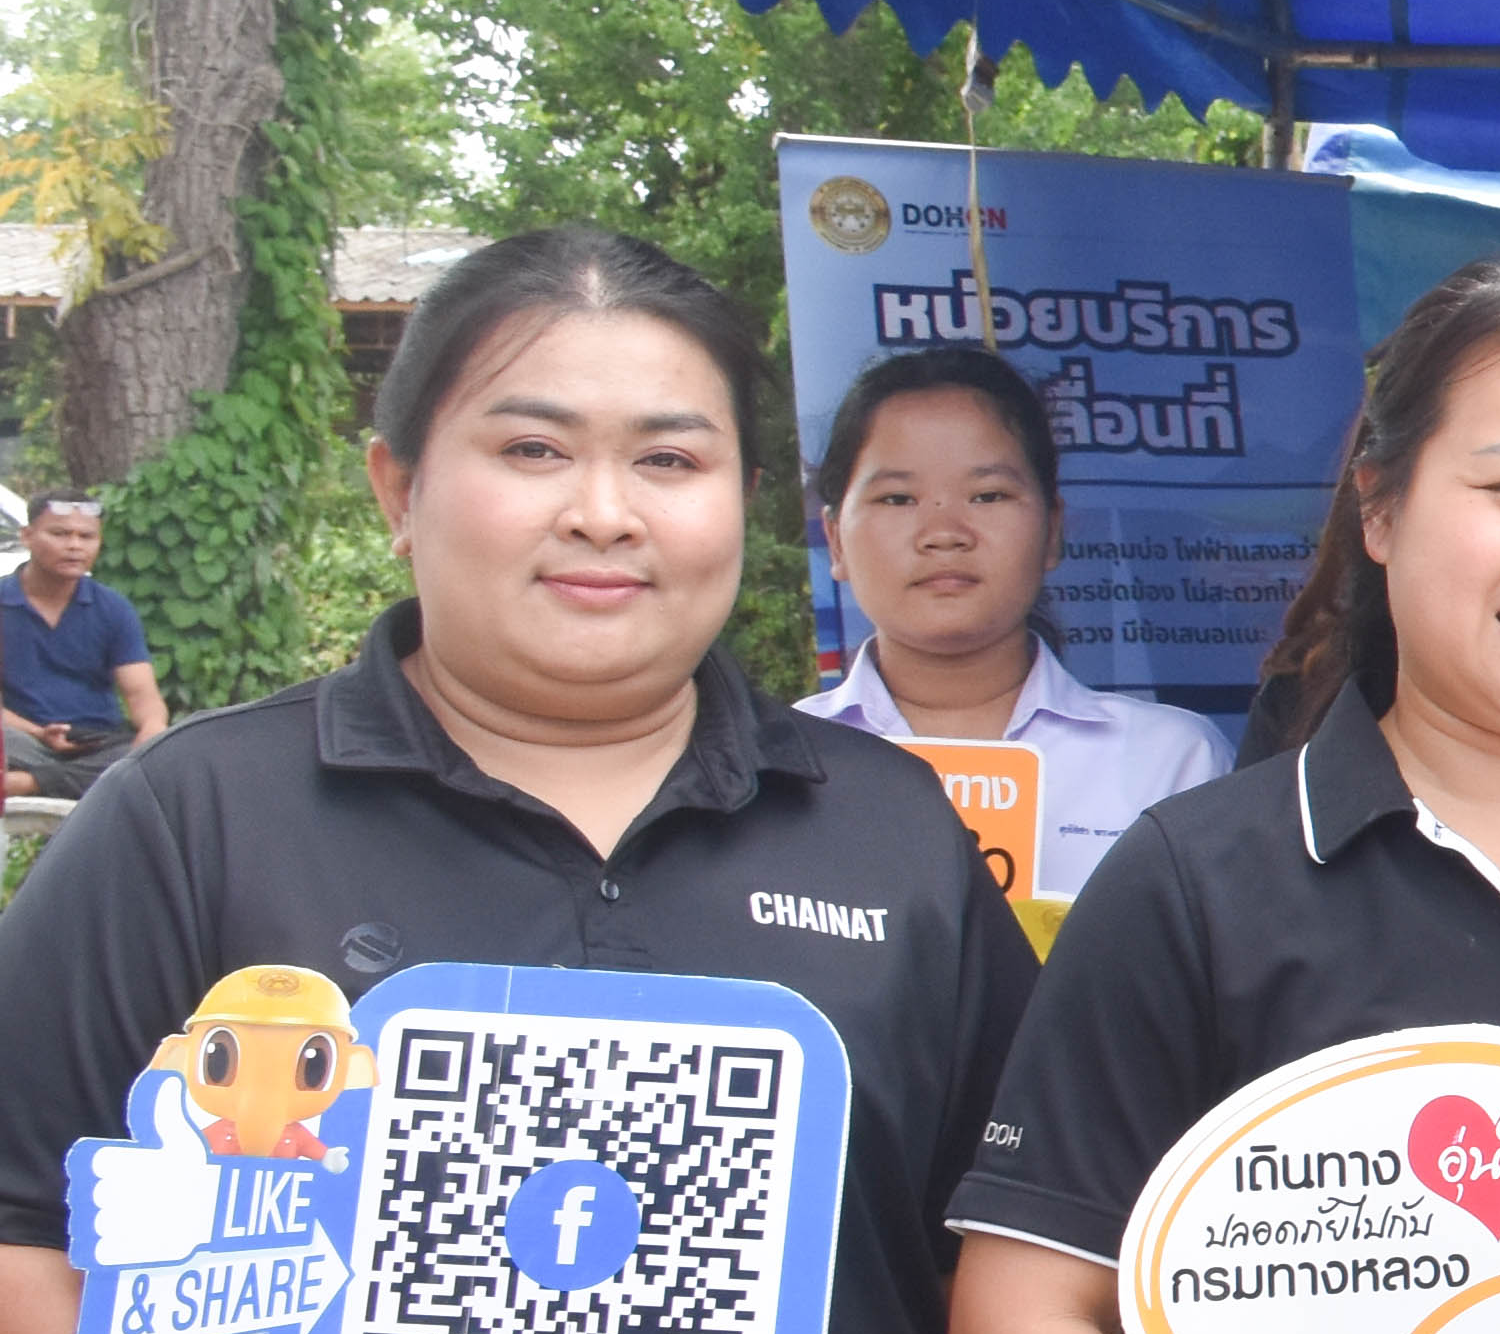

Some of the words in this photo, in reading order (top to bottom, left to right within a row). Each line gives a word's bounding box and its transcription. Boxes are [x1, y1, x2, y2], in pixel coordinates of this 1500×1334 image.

[750, 891, 888, 942] CHAINAT
[984, 1121, 1023, 1149] DOH
[1234, 1143, 1402, 1194] เดินทาง
[222, 1169, 314, 1239] LIKE
[1204, 1195, 1434, 1251] ปลอดภัยไปกับ
[172, 1253, 324, 1329] SHARE
[1170, 1249, 1471, 1303] กรมทางหลวง
